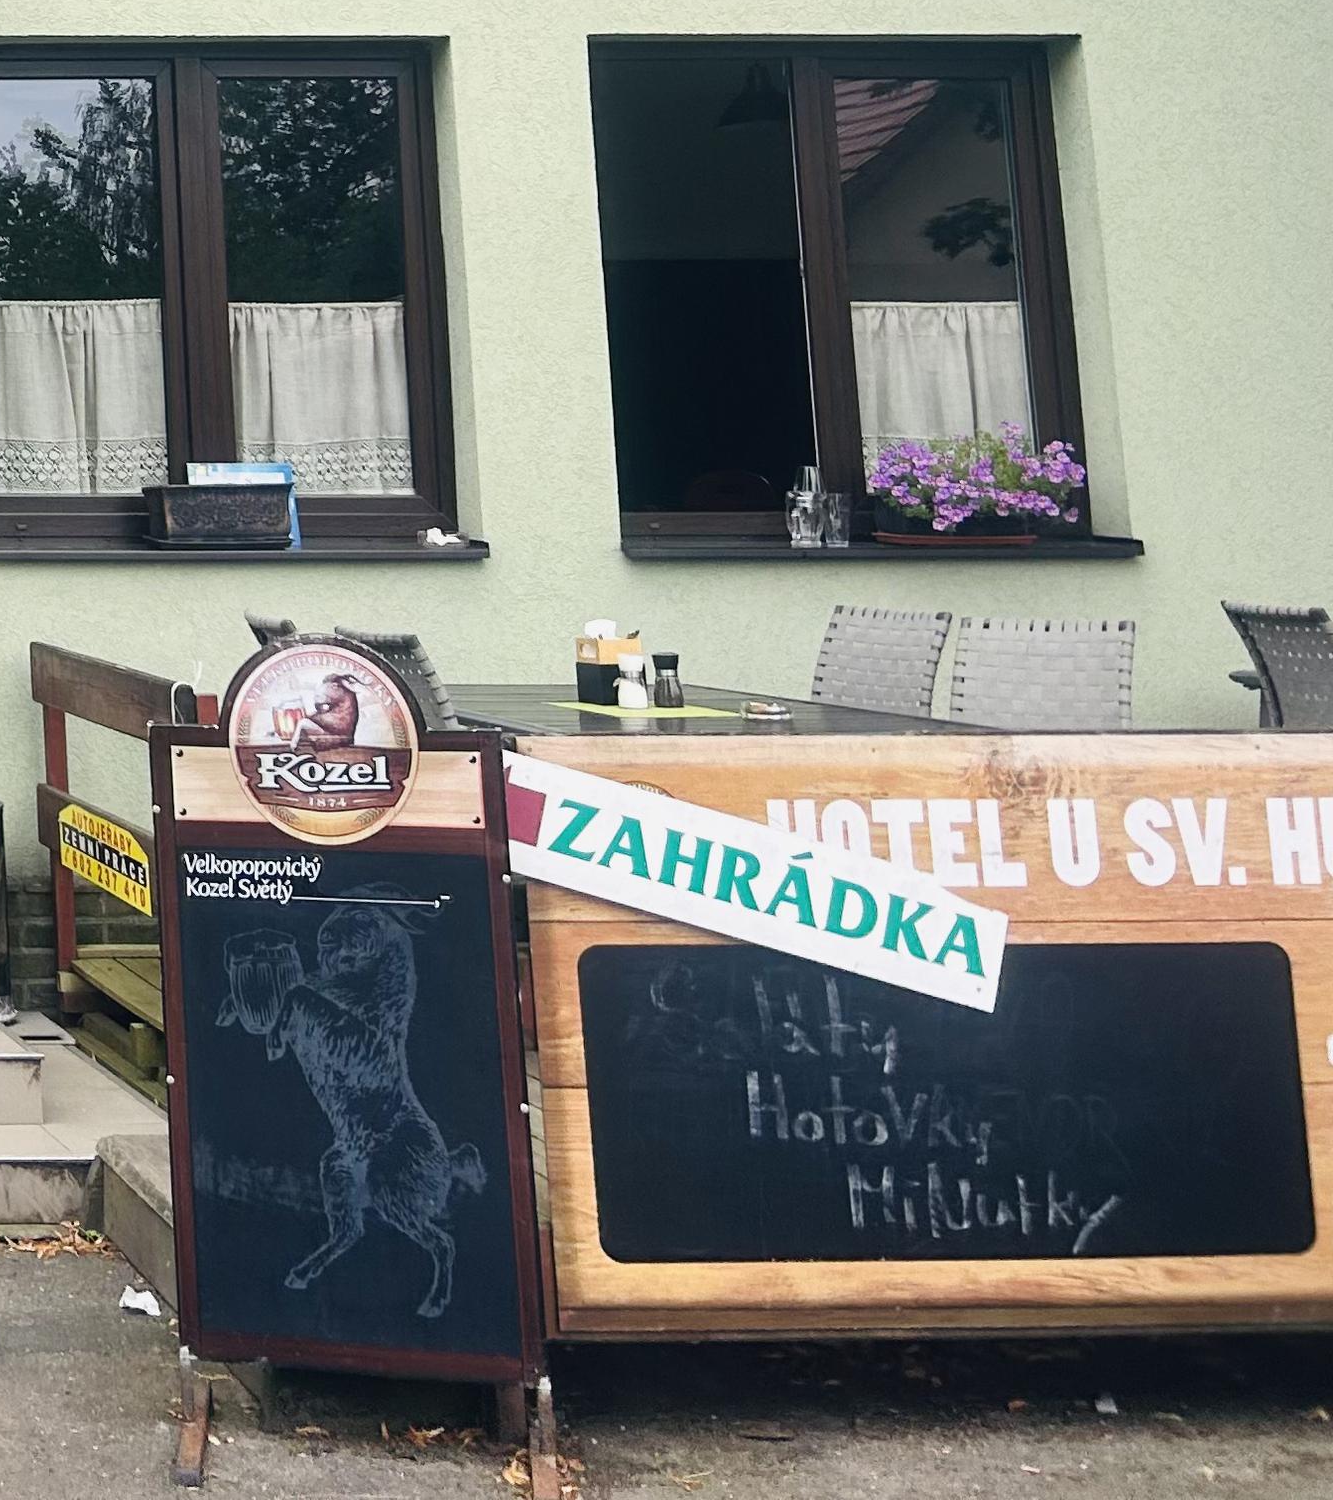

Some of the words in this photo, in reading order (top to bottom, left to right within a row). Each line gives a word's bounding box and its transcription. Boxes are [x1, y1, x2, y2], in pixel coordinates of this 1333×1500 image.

[255, 752, 393, 794] Kozel
[308, 796, 348, 808] 1874
[1046, 797, 1101, 888] U
[1123, 797, 1248, 888] SV.
[1264, 796, 1333, 887] H
[182, 852, 322, 883] Velkopopovický
[185, 876, 236, 898] Kozel
[237, 878, 294, 905] Světlý
[547, 798, 988, 979] ZAHRÁDKA
